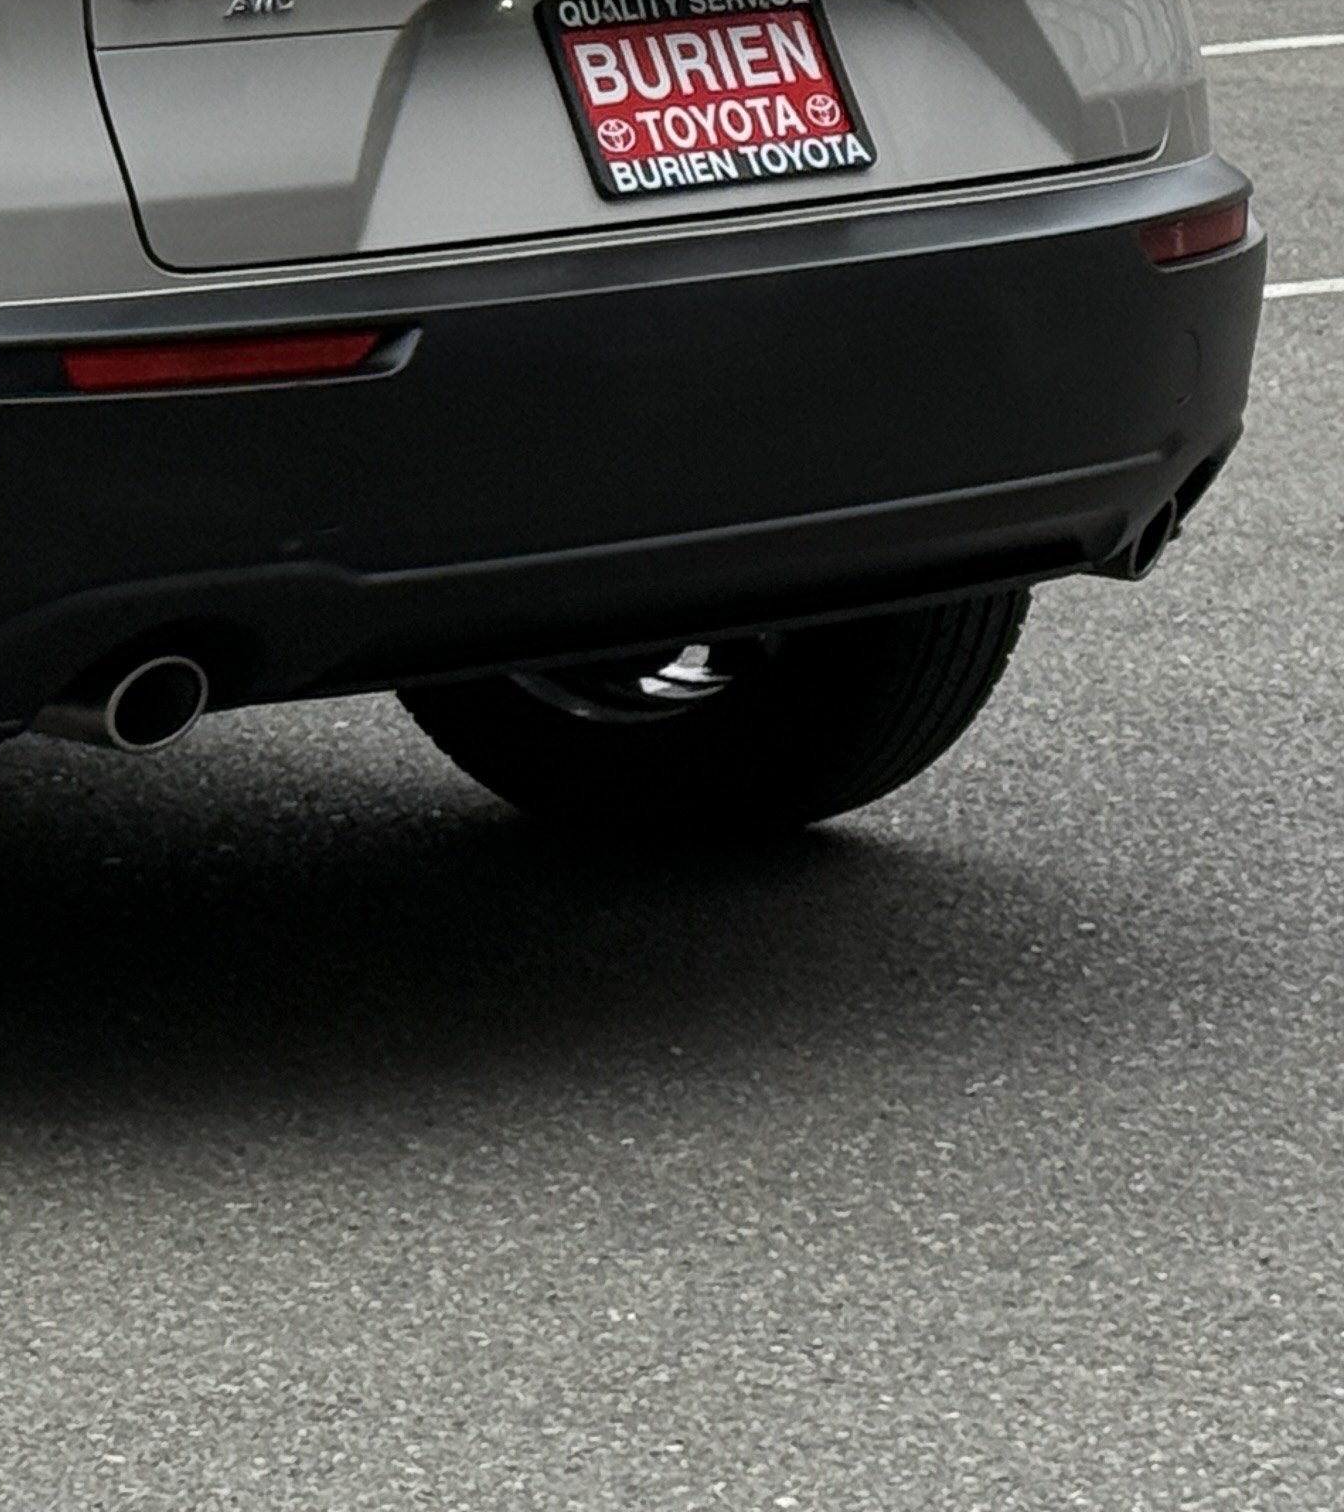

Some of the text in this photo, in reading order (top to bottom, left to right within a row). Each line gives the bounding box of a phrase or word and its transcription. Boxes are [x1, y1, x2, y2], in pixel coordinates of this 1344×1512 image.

[573, 19, 823, 107] BURIEN
[635, 93, 808, 153] TOYOTA
[609, 132, 871, 193] BURIEN TOYOTA
